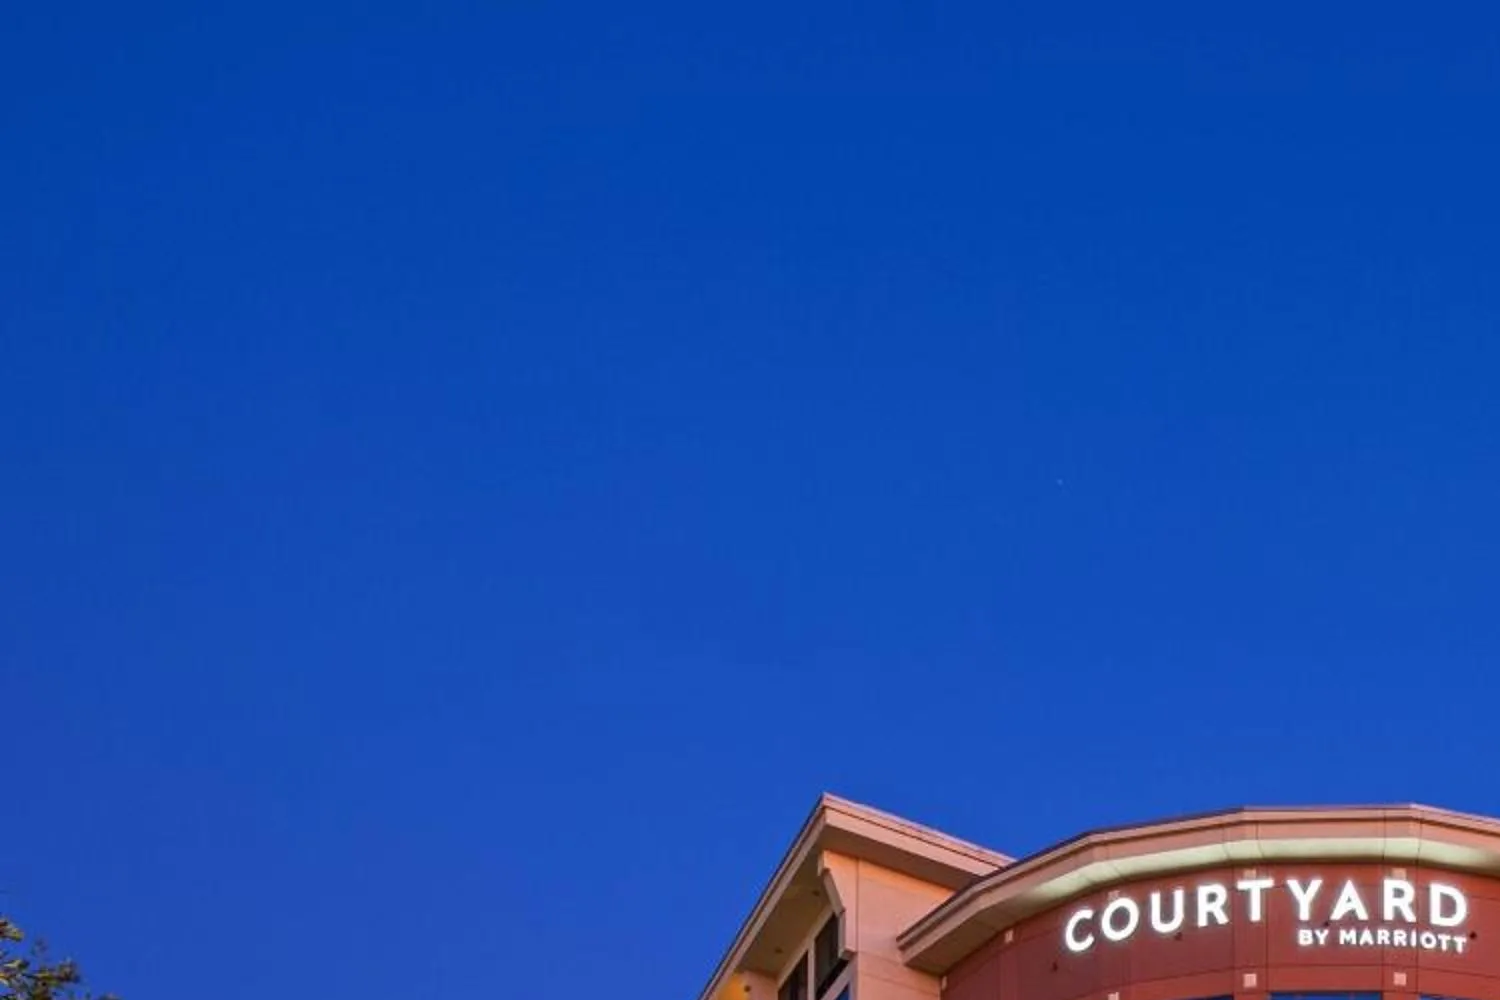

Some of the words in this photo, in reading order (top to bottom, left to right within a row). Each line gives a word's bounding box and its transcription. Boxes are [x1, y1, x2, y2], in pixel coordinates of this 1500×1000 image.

[1065, 878, 1468, 952] COURTYARD
[1298, 928, 1330, 946] BY
[1339, 929, 1467, 953] MARRIOTT
